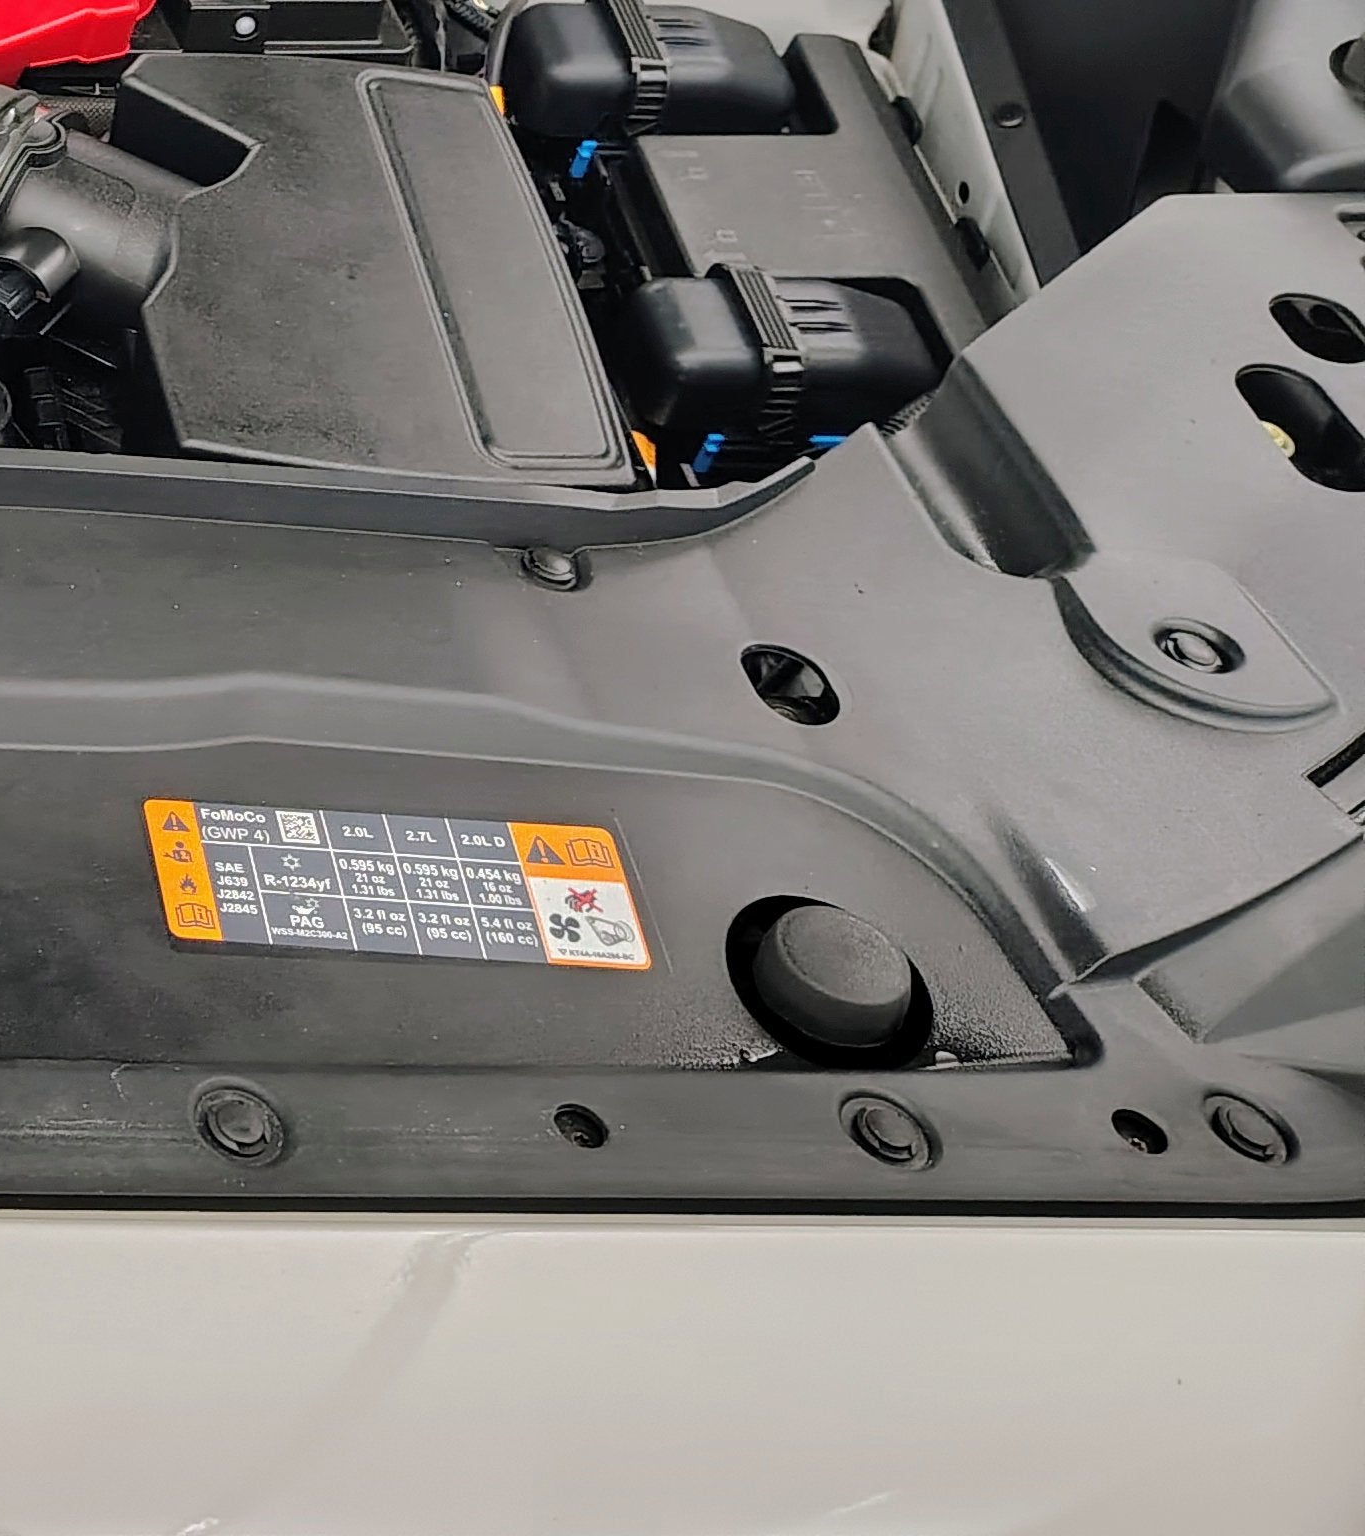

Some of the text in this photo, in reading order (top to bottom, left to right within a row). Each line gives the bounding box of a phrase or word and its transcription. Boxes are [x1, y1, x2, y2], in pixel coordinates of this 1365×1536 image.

[200, 808, 266, 823] FoMoCo
[202, 825, 270, 844] (GWP 4)
[342, 826, 506, 848] 2.0L 2.7L 2.0L D
[215, 862, 245, 874] SAE
[339, 858, 521, 886] 0.595 kg 0.595 kg 0.454 kg
[217, 875, 248, 887] J639
[263, 873, 331, 893] R-1234yf
[355, 872, 369, 883] 21
[372, 875, 386, 884] oz
[419, 877, 433, 888] 21
[435, 880, 450, 889] oz
[498, 884, 513, 893] oz
[217, 889, 255, 901] J2842
[351, 883, 523, 906] 1.31 lbs 1.31 lbs 1.00 lbs
[220, 903, 258, 915] J2845
[289, 915, 325, 929] PAG
[353, 908, 534, 931] 3.2 fl oz 3.2 fl oz 5.4 fl oz
[362, 923, 539, 947] (95 cc) (95 cc) (160 cc)
